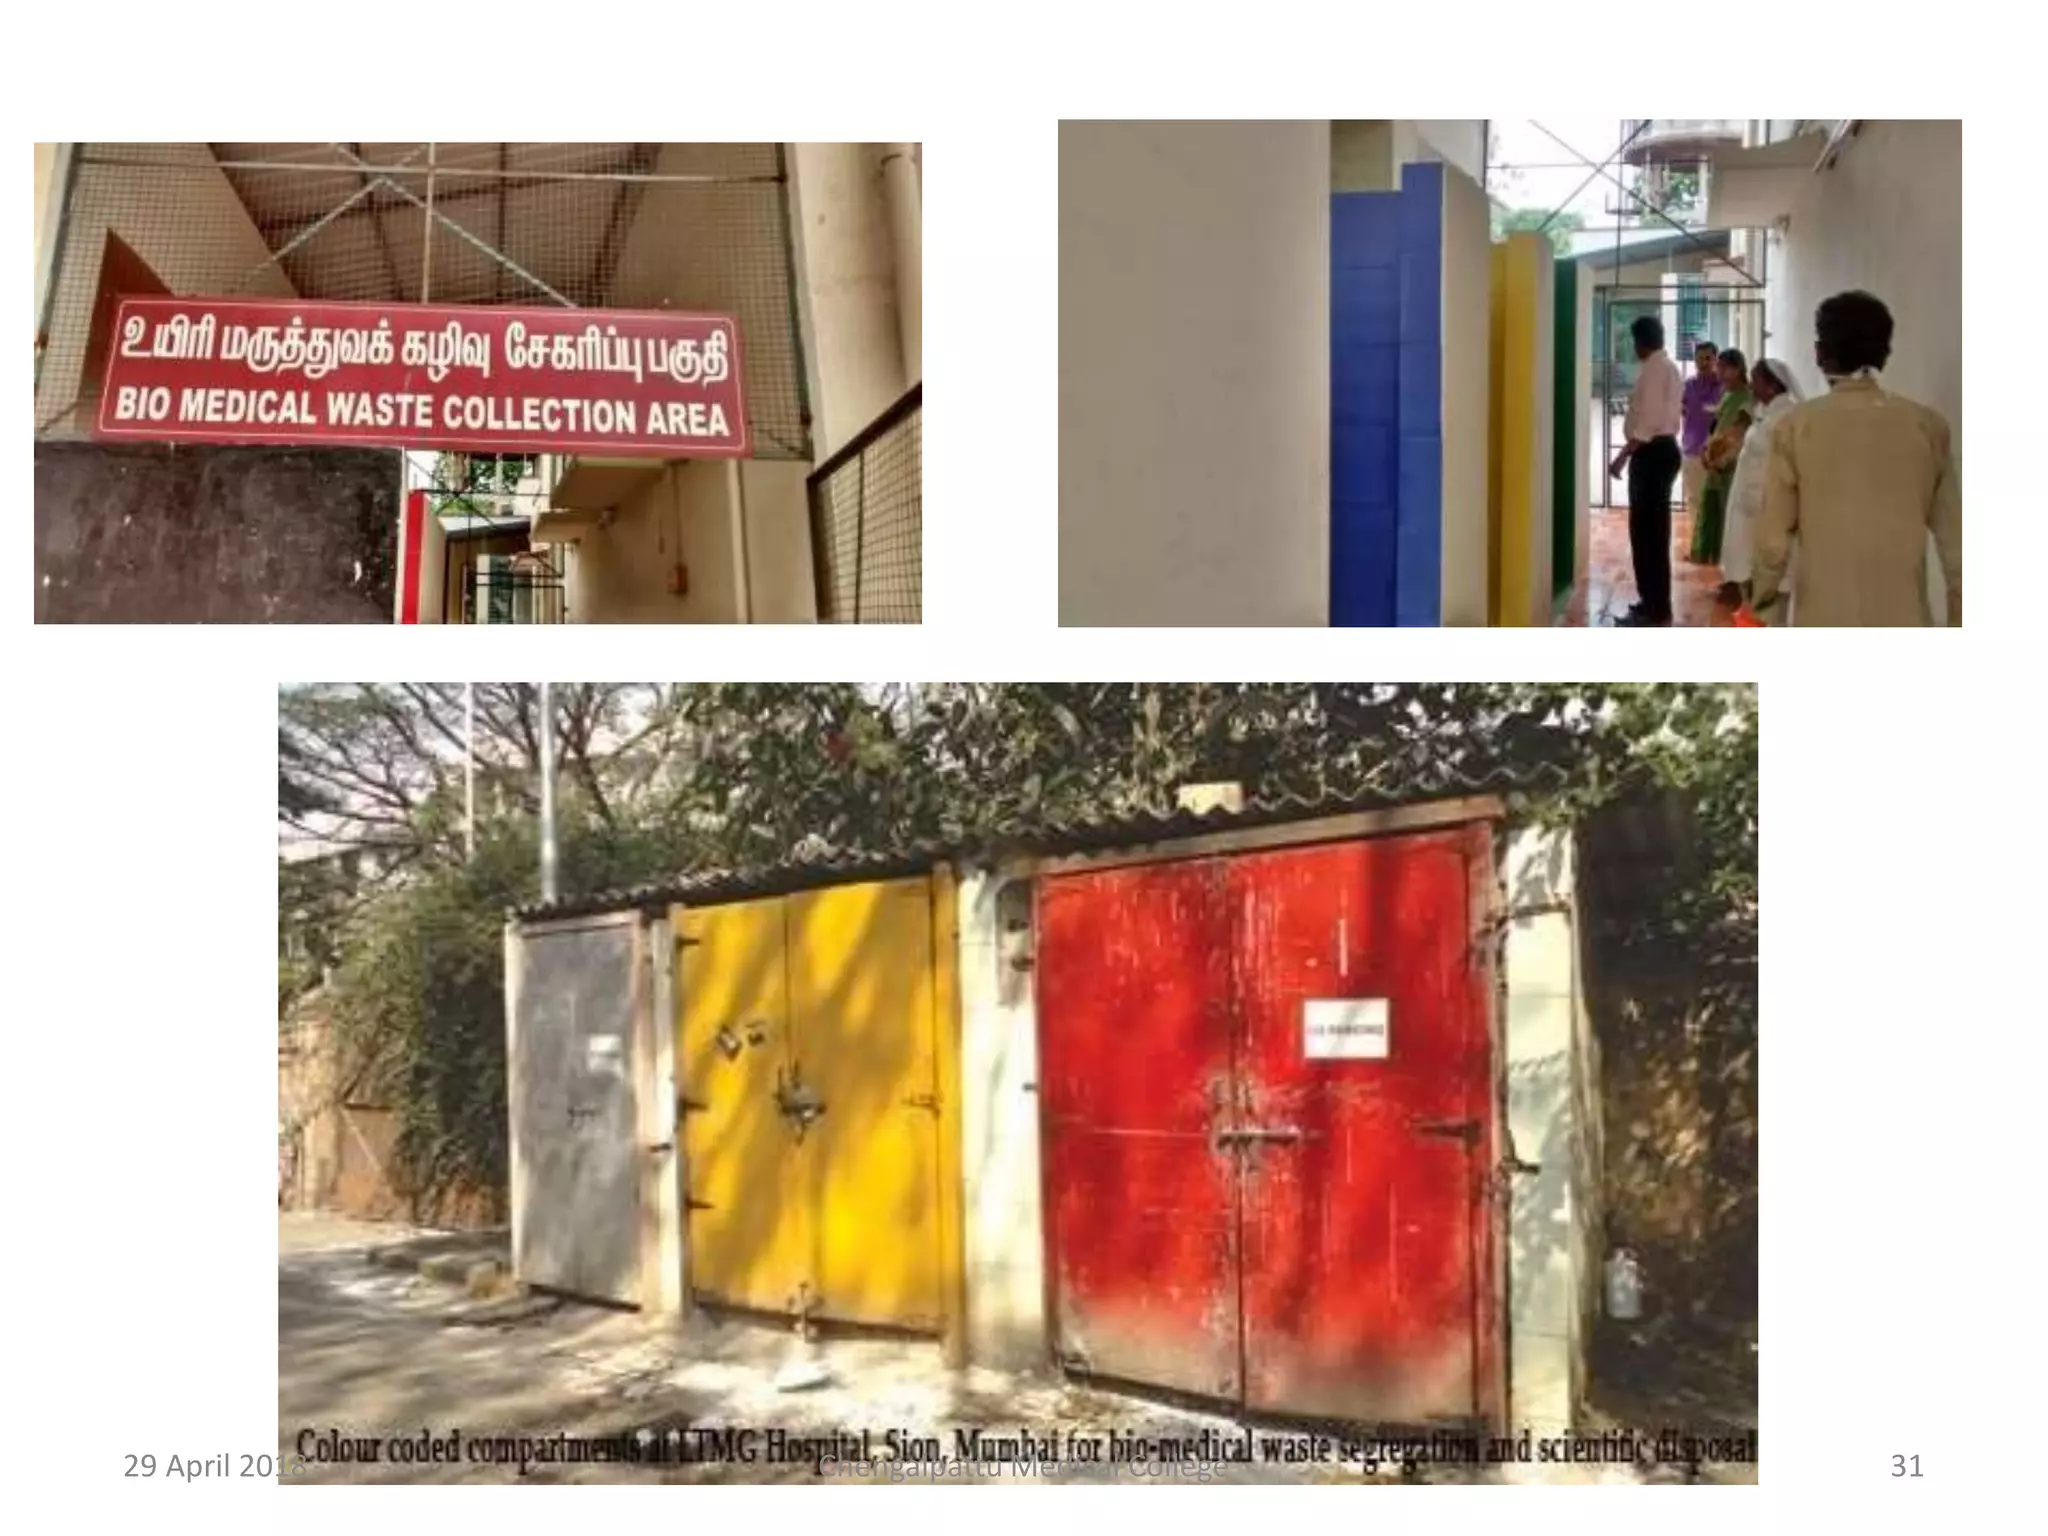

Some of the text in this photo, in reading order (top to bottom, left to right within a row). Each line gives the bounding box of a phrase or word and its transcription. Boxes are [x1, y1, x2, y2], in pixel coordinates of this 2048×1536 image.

[121, 313, 728, 391] உயிரி மருத்துவக் கழிவு சேகரிப்பு பகுதி
[115, 386, 731, 437] BIO MEDICAL WASTE COLLECTION AREA
